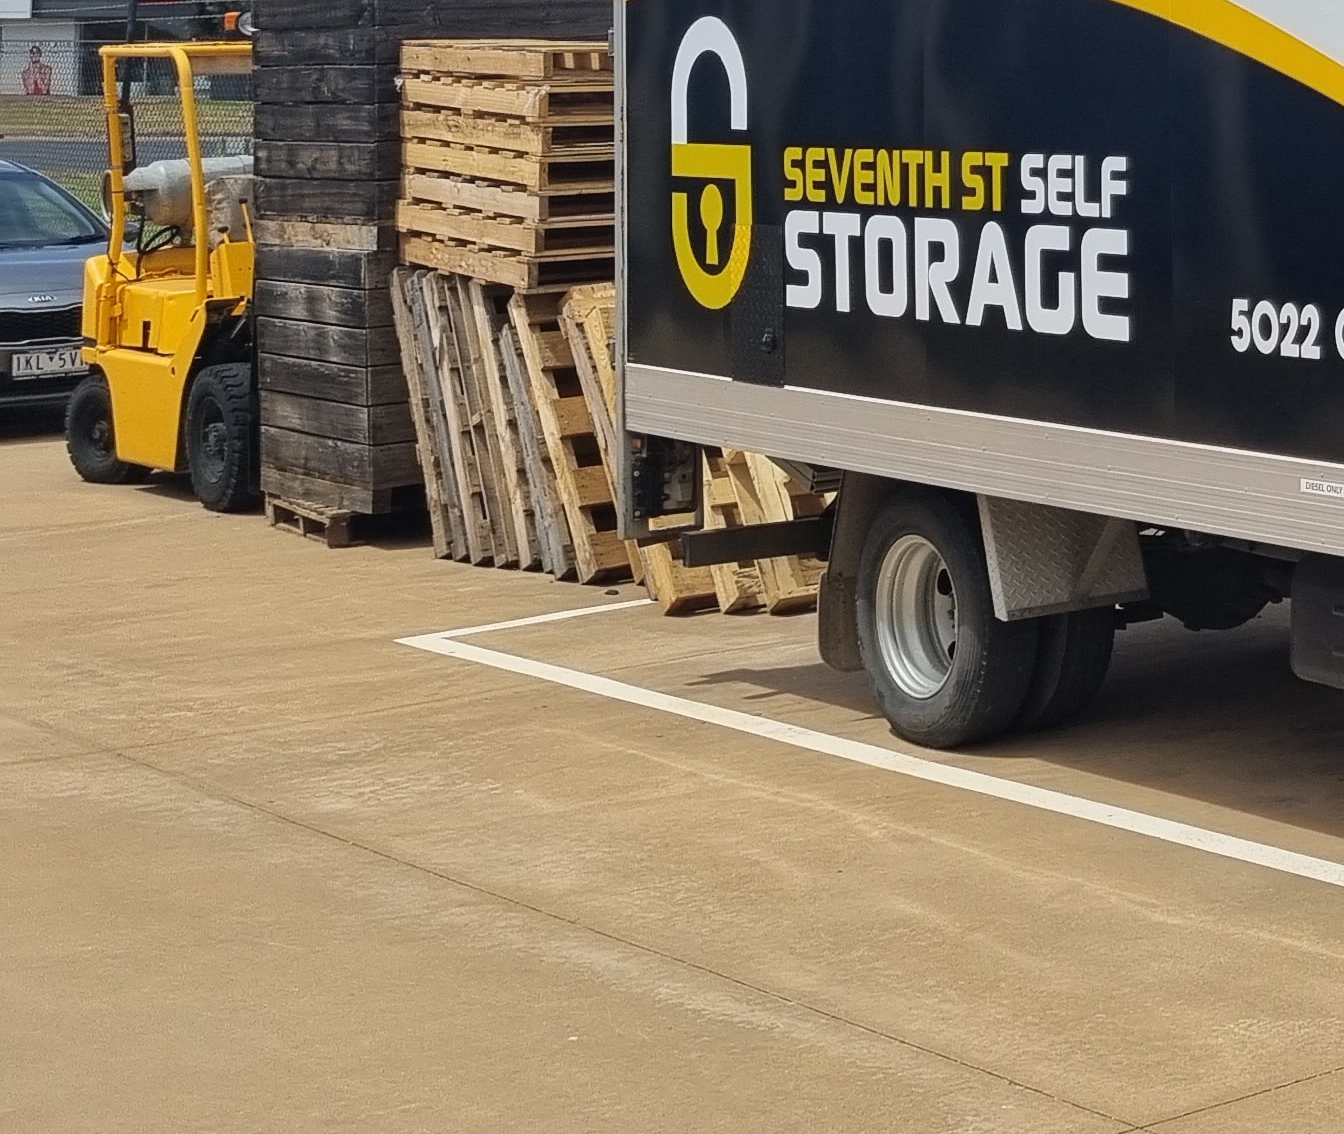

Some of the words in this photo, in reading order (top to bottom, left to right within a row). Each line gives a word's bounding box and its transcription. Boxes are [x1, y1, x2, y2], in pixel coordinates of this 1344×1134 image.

[783, 146, 950, 209] SEVENTH
[961, 151, 1009, 211] ST
[1020, 153, 1127, 219] SELF
[784, 209, 1131, 342] STORAGE
[1230, 298, 1321, 360] 5022
[1305, 481, 1325, 493] DIESEL
[1326, 484, 1343, 495] ONLY
